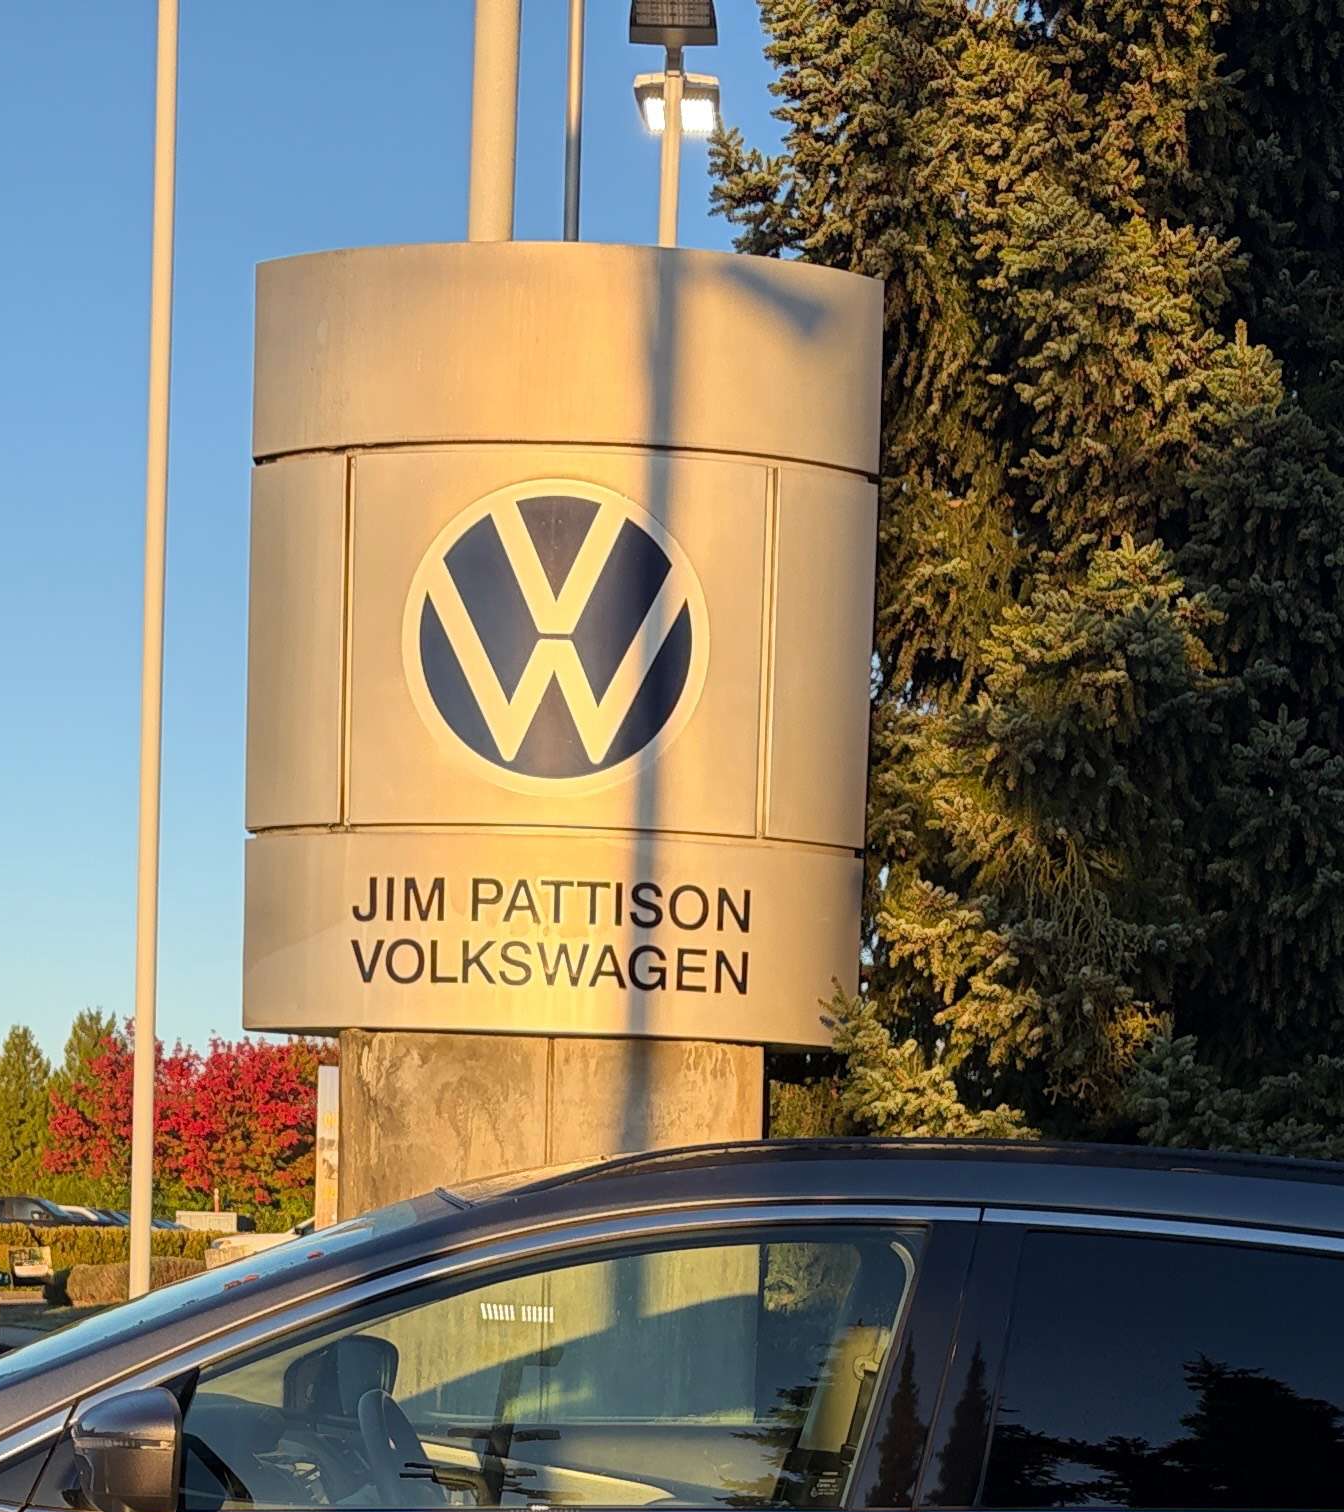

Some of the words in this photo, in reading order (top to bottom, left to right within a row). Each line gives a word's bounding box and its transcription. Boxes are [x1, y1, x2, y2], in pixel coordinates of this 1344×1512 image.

[352, 876, 446, 922] JIM
[471, 877, 752, 934] PATTISON
[350, 938, 750, 996] VOLKSWAGEN
